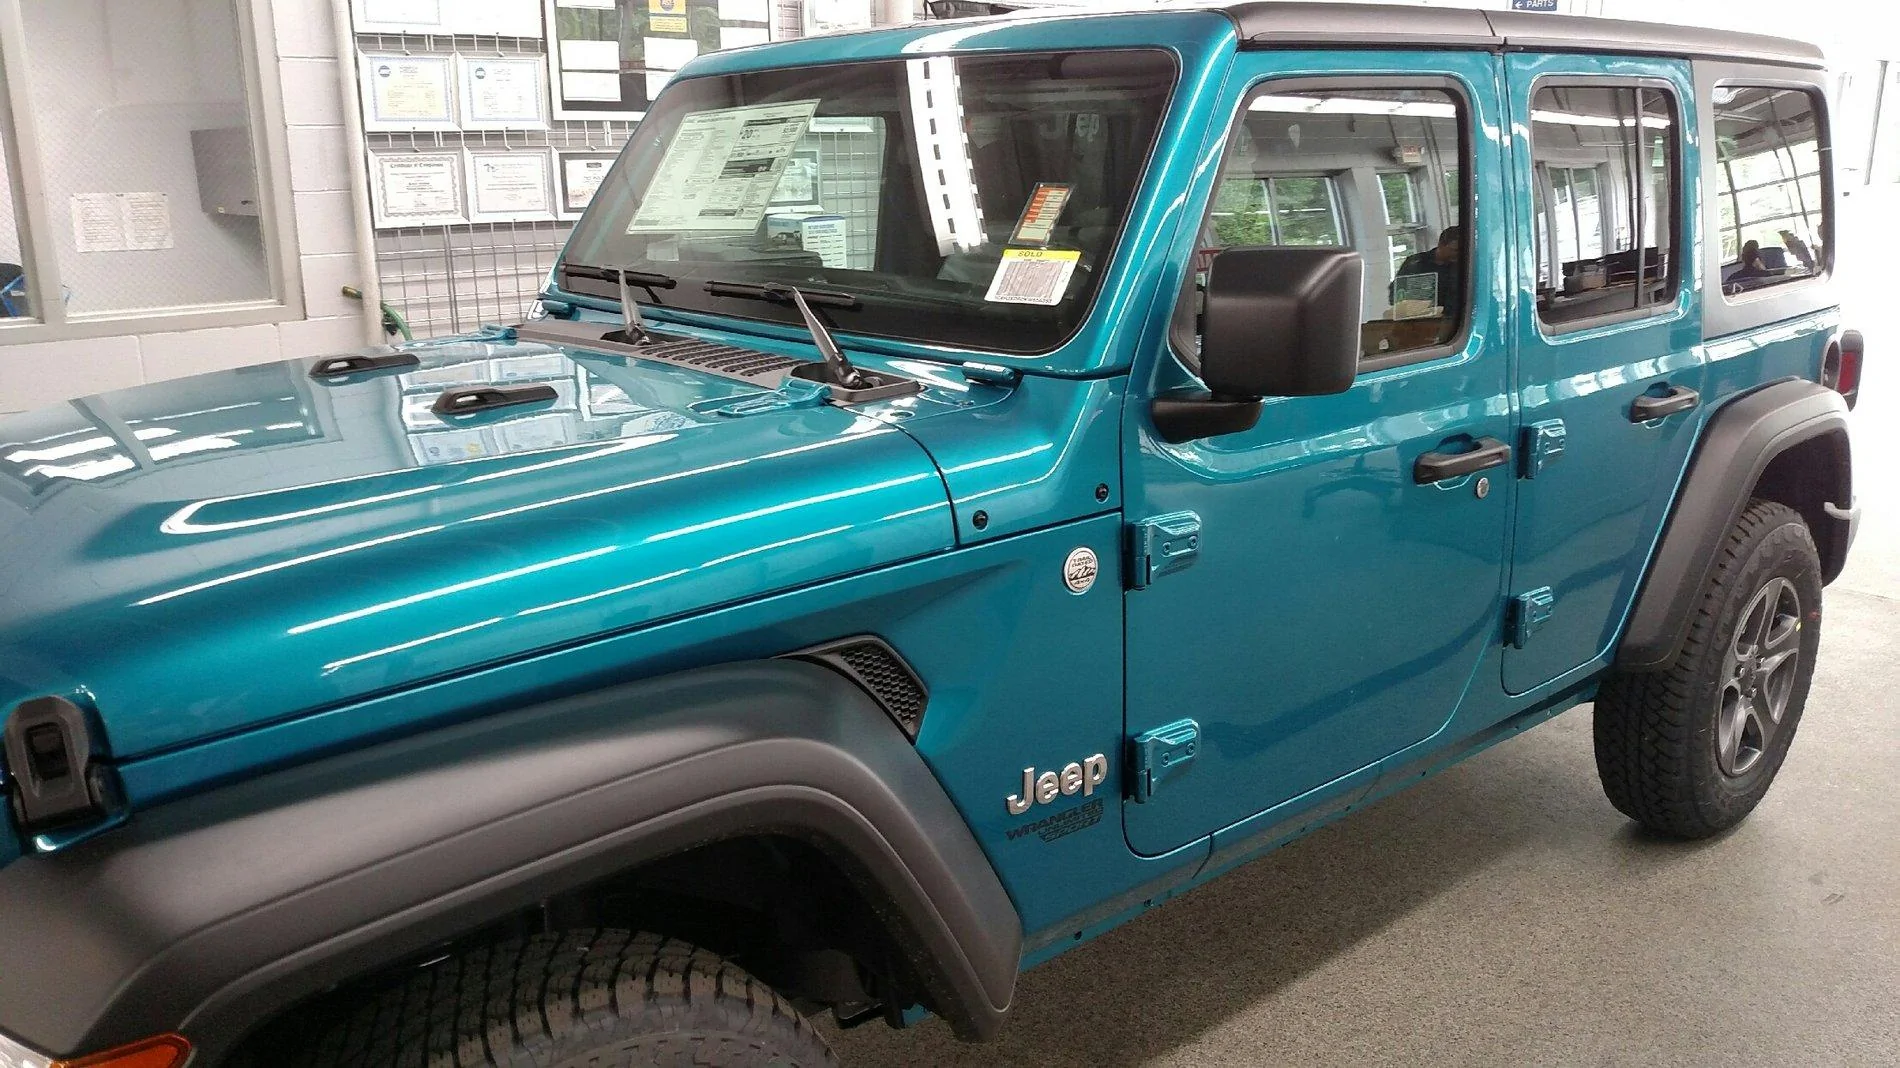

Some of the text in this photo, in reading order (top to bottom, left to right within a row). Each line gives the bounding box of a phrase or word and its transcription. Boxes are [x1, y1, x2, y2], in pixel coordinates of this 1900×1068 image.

[1526, 0, 1554, 8] PARTS
[1006, 753, 1108, 815] Jeep
[1005, 797, 1103, 840] WRANGLER
